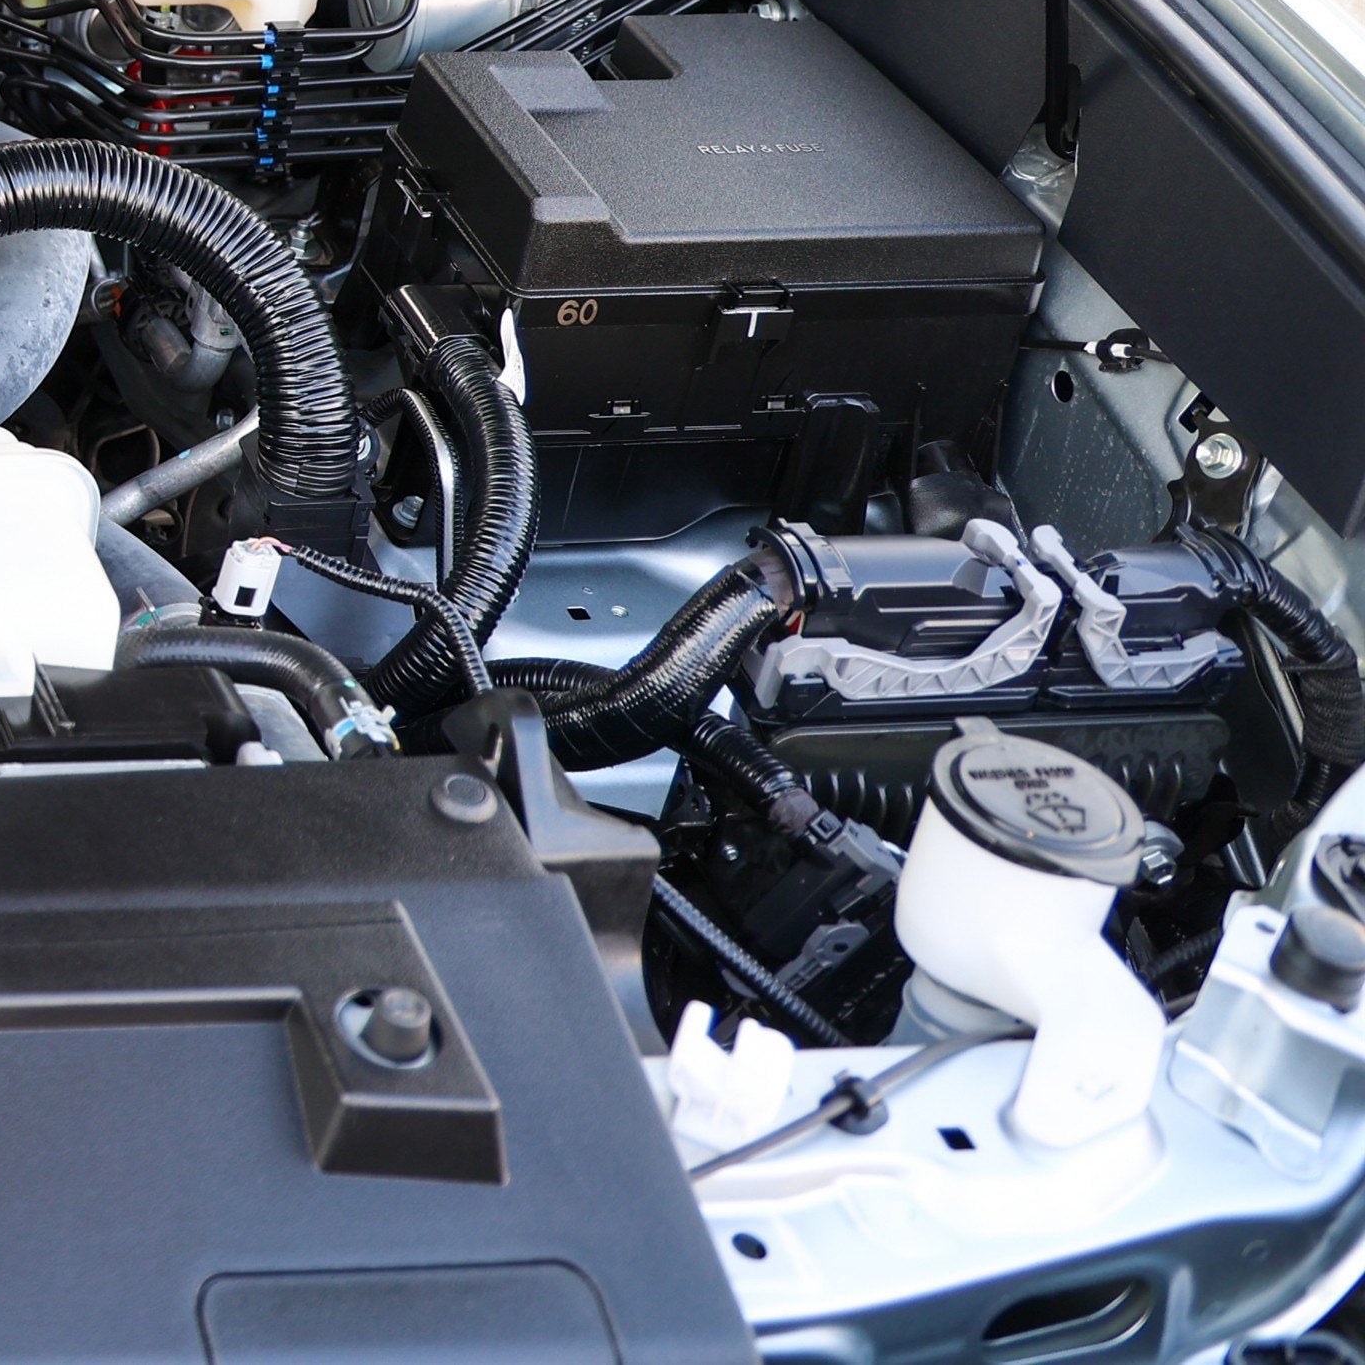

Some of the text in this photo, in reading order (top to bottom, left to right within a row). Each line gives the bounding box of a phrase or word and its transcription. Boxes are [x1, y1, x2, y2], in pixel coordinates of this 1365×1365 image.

[697, 143, 825, 155] RELAY & FUSE
[557, 299, 599, 326] 60
